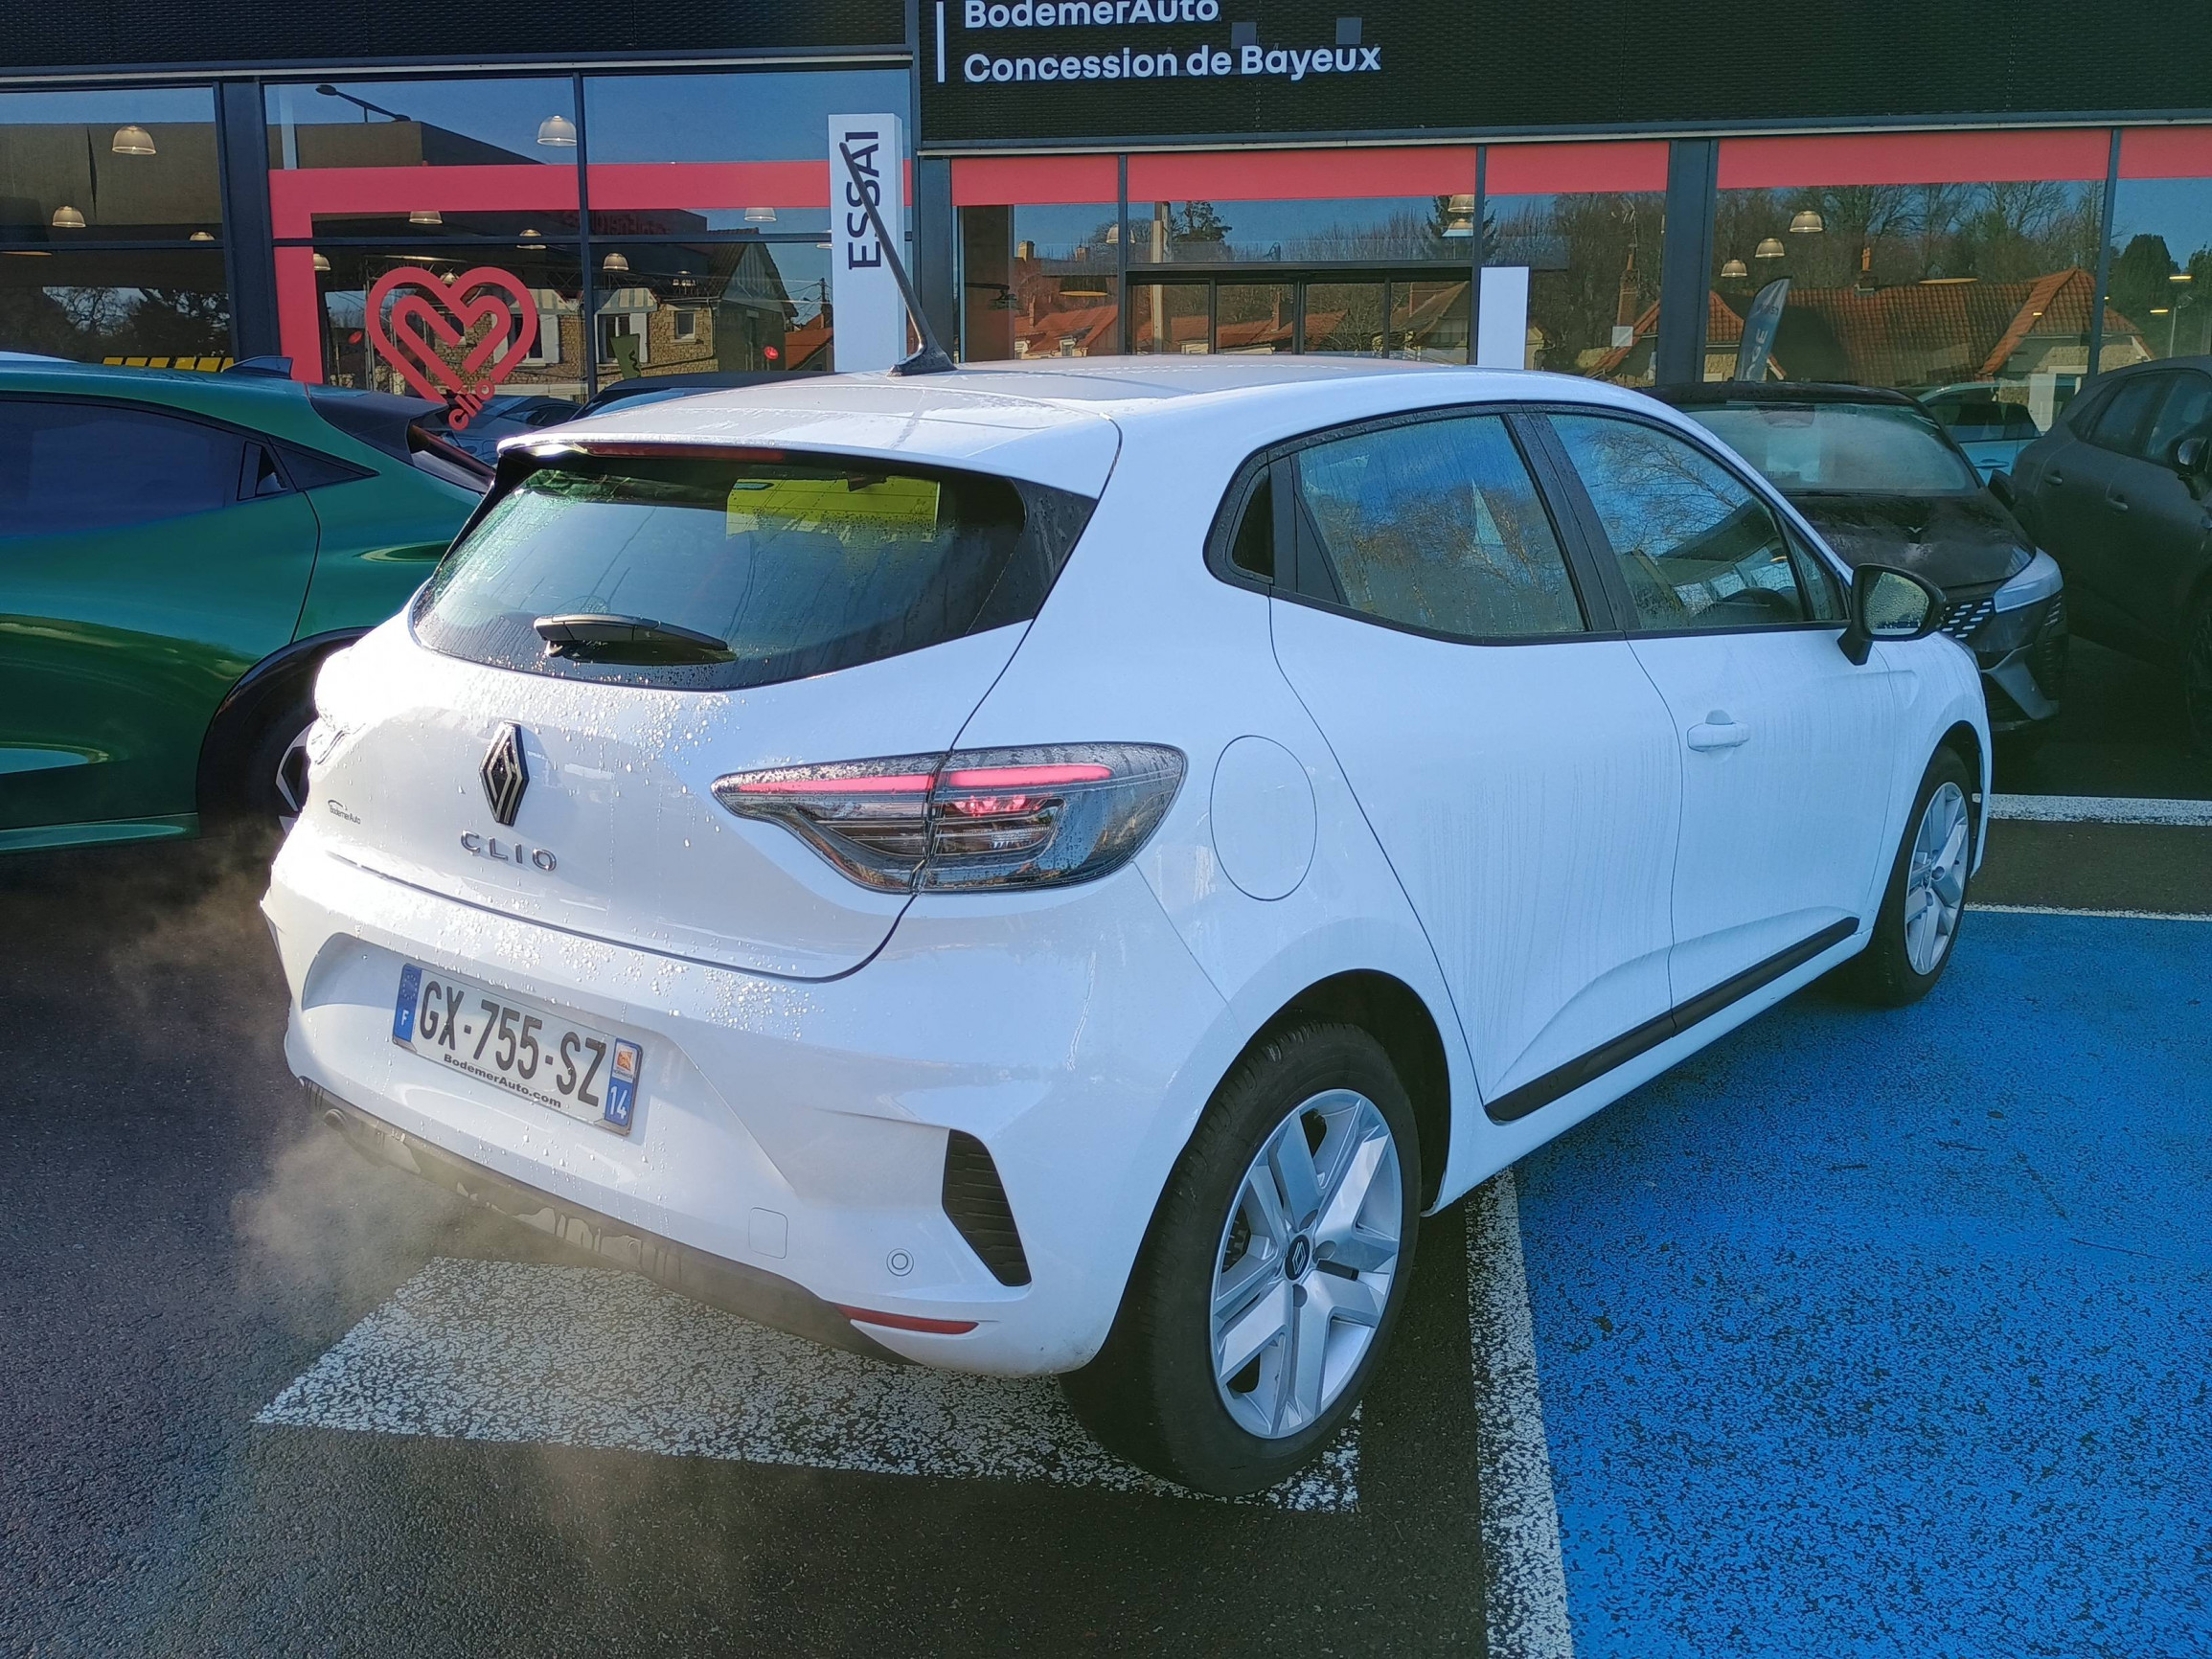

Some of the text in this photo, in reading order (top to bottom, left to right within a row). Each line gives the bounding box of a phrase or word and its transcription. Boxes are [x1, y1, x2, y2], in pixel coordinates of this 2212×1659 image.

[965, 0, 1220, 28] BodemerAuto
[964, 44, 1381, 82] Concession de Bayeux
[845, 131, 881, 270] ESSAI
[448, 379, 495, 431] clio
[460, 830, 557, 872] CLIO
[400, 1009, 410, 1026] F
[420, 980, 607, 1107] GX-755-SZ
[444, 1054, 562, 1108] BodemerAuto.com
[610, 1085, 628, 1120] 14
